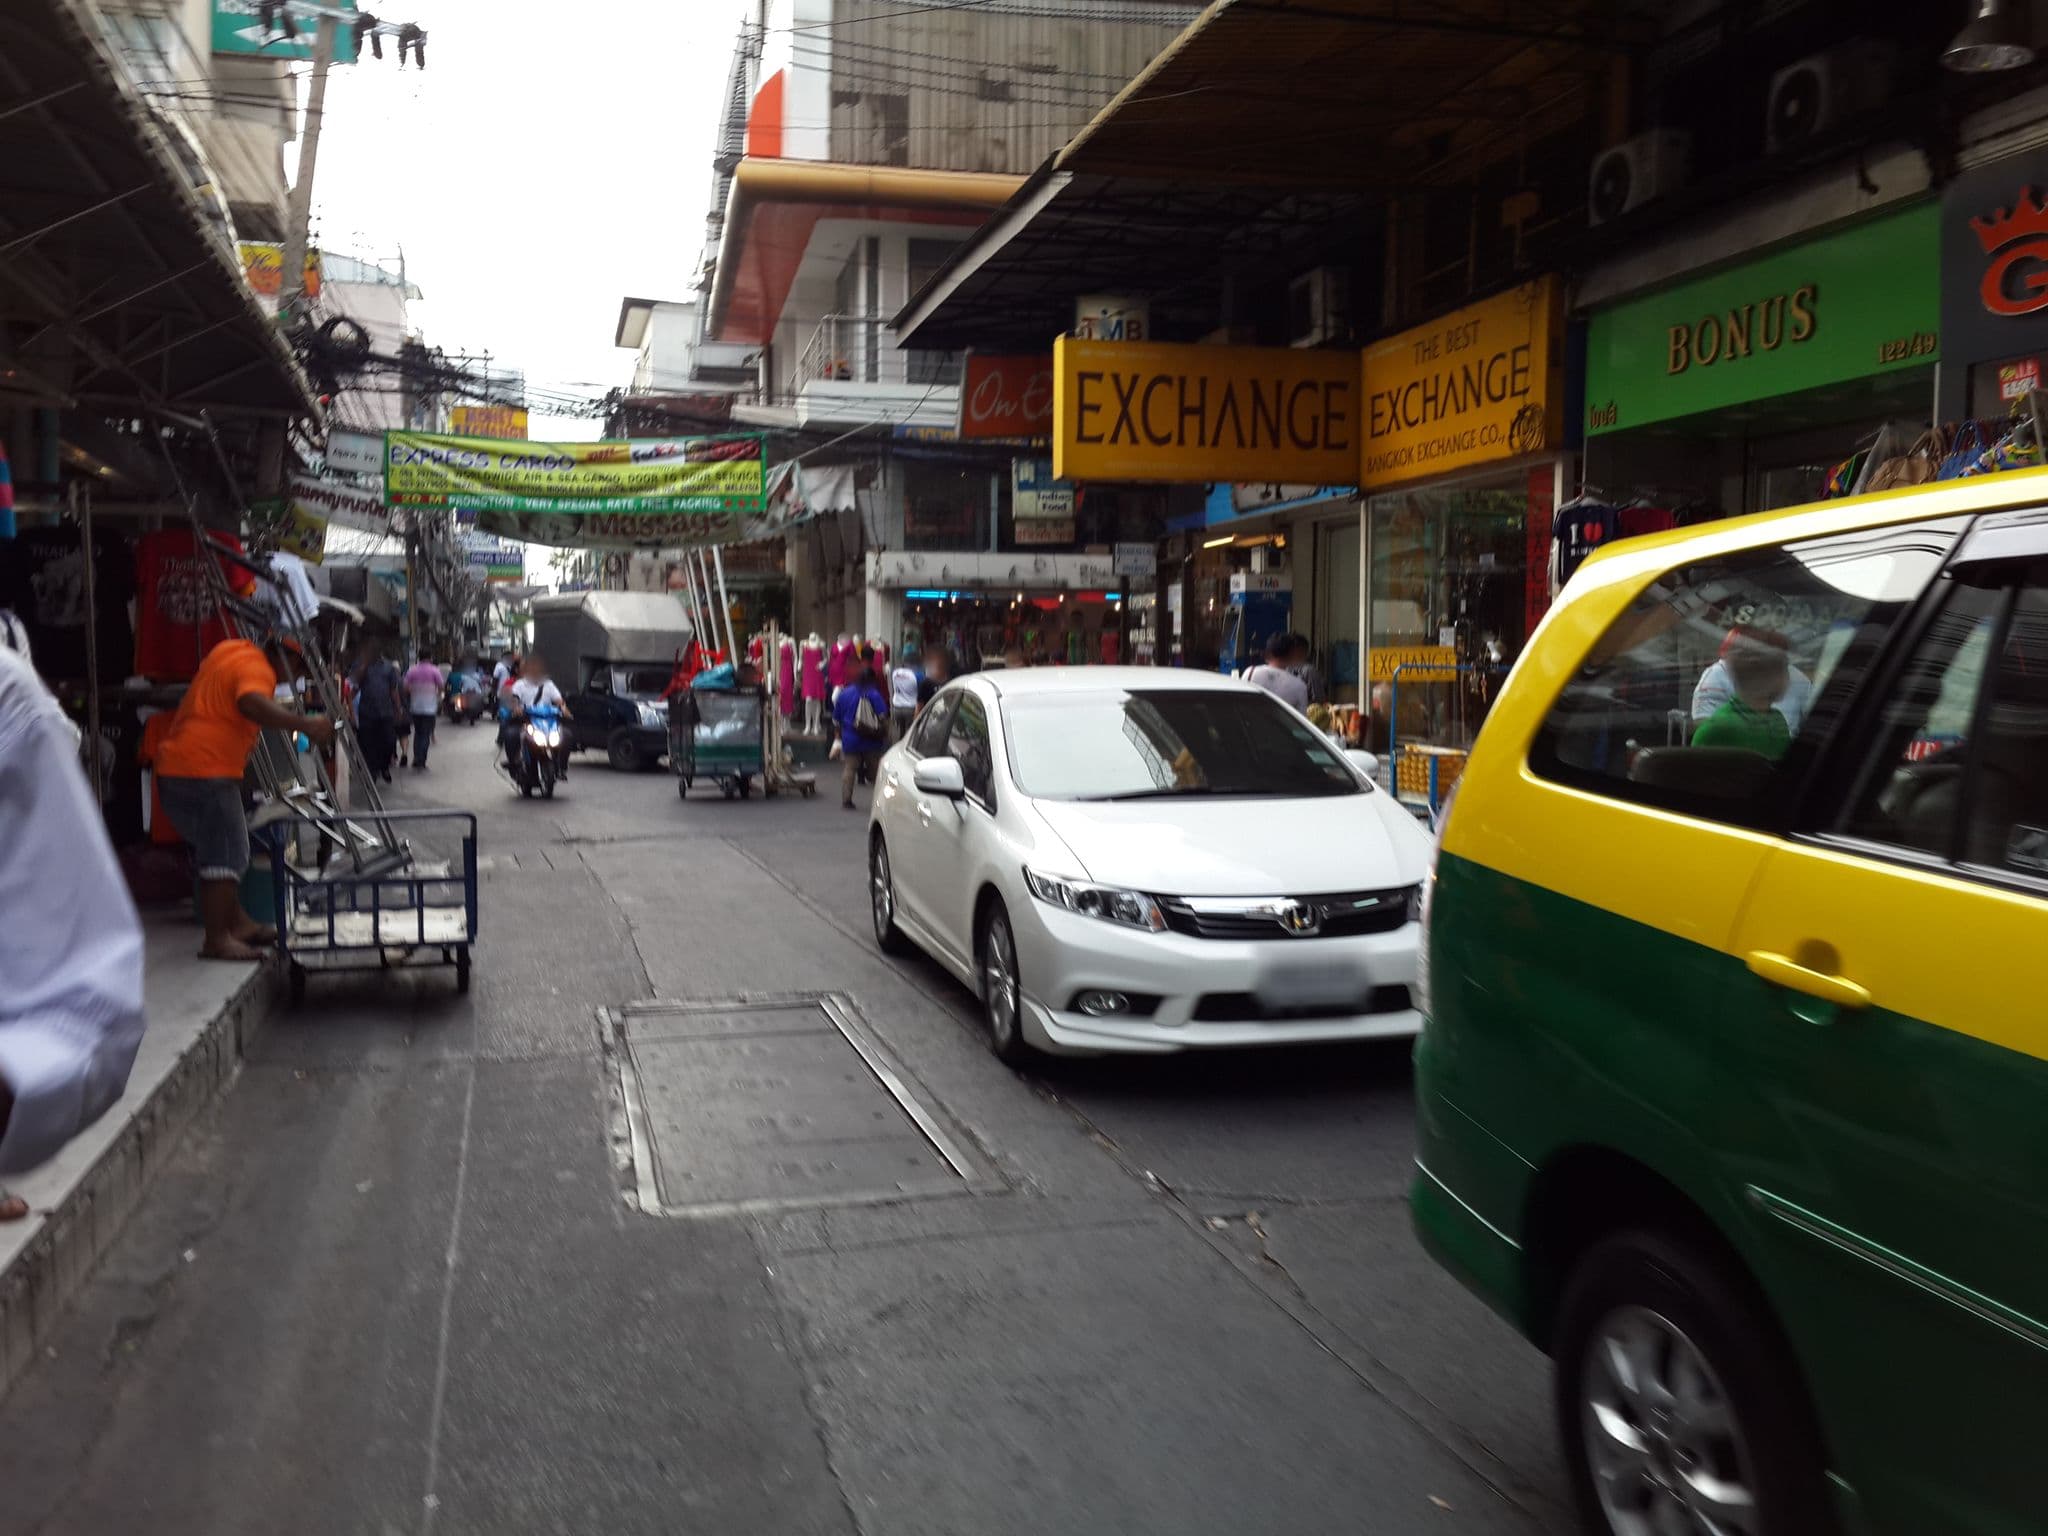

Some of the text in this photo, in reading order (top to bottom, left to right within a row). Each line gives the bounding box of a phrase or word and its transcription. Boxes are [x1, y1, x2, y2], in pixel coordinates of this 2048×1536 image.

[1413, 319, 1482, 365] THE BEST
[1667, 283, 1818, 375] BONUS
[1878, 332, 1938, 364] 122/49
[1022, 370, 1054, 421] E
[1369, 343, 1532, 440] EXCHANGE
[1075, 372, 1351, 452] EXCHANGE
[390, 446, 490, 470] EXPRESS
[499, 452, 577, 471] CARGO
[1367, 443, 1415, 474] BANGKOK
[1417, 428, 1477, 463] EXCHANGE
[456, 468, 520, 481] WORLDWIDE
[523, 472, 542, 482] AIR
[628, 472, 658, 483] DOOR
[525, 498, 552, 510] VERY
[557, 498, 601, 510] SPECIAL
[672, 497, 722, 510] PACKING
[1042, 502, 1067, 512] Food
[1569, 522, 1579, 545] I
[1372, 653, 1452, 676] EXCHANGE
